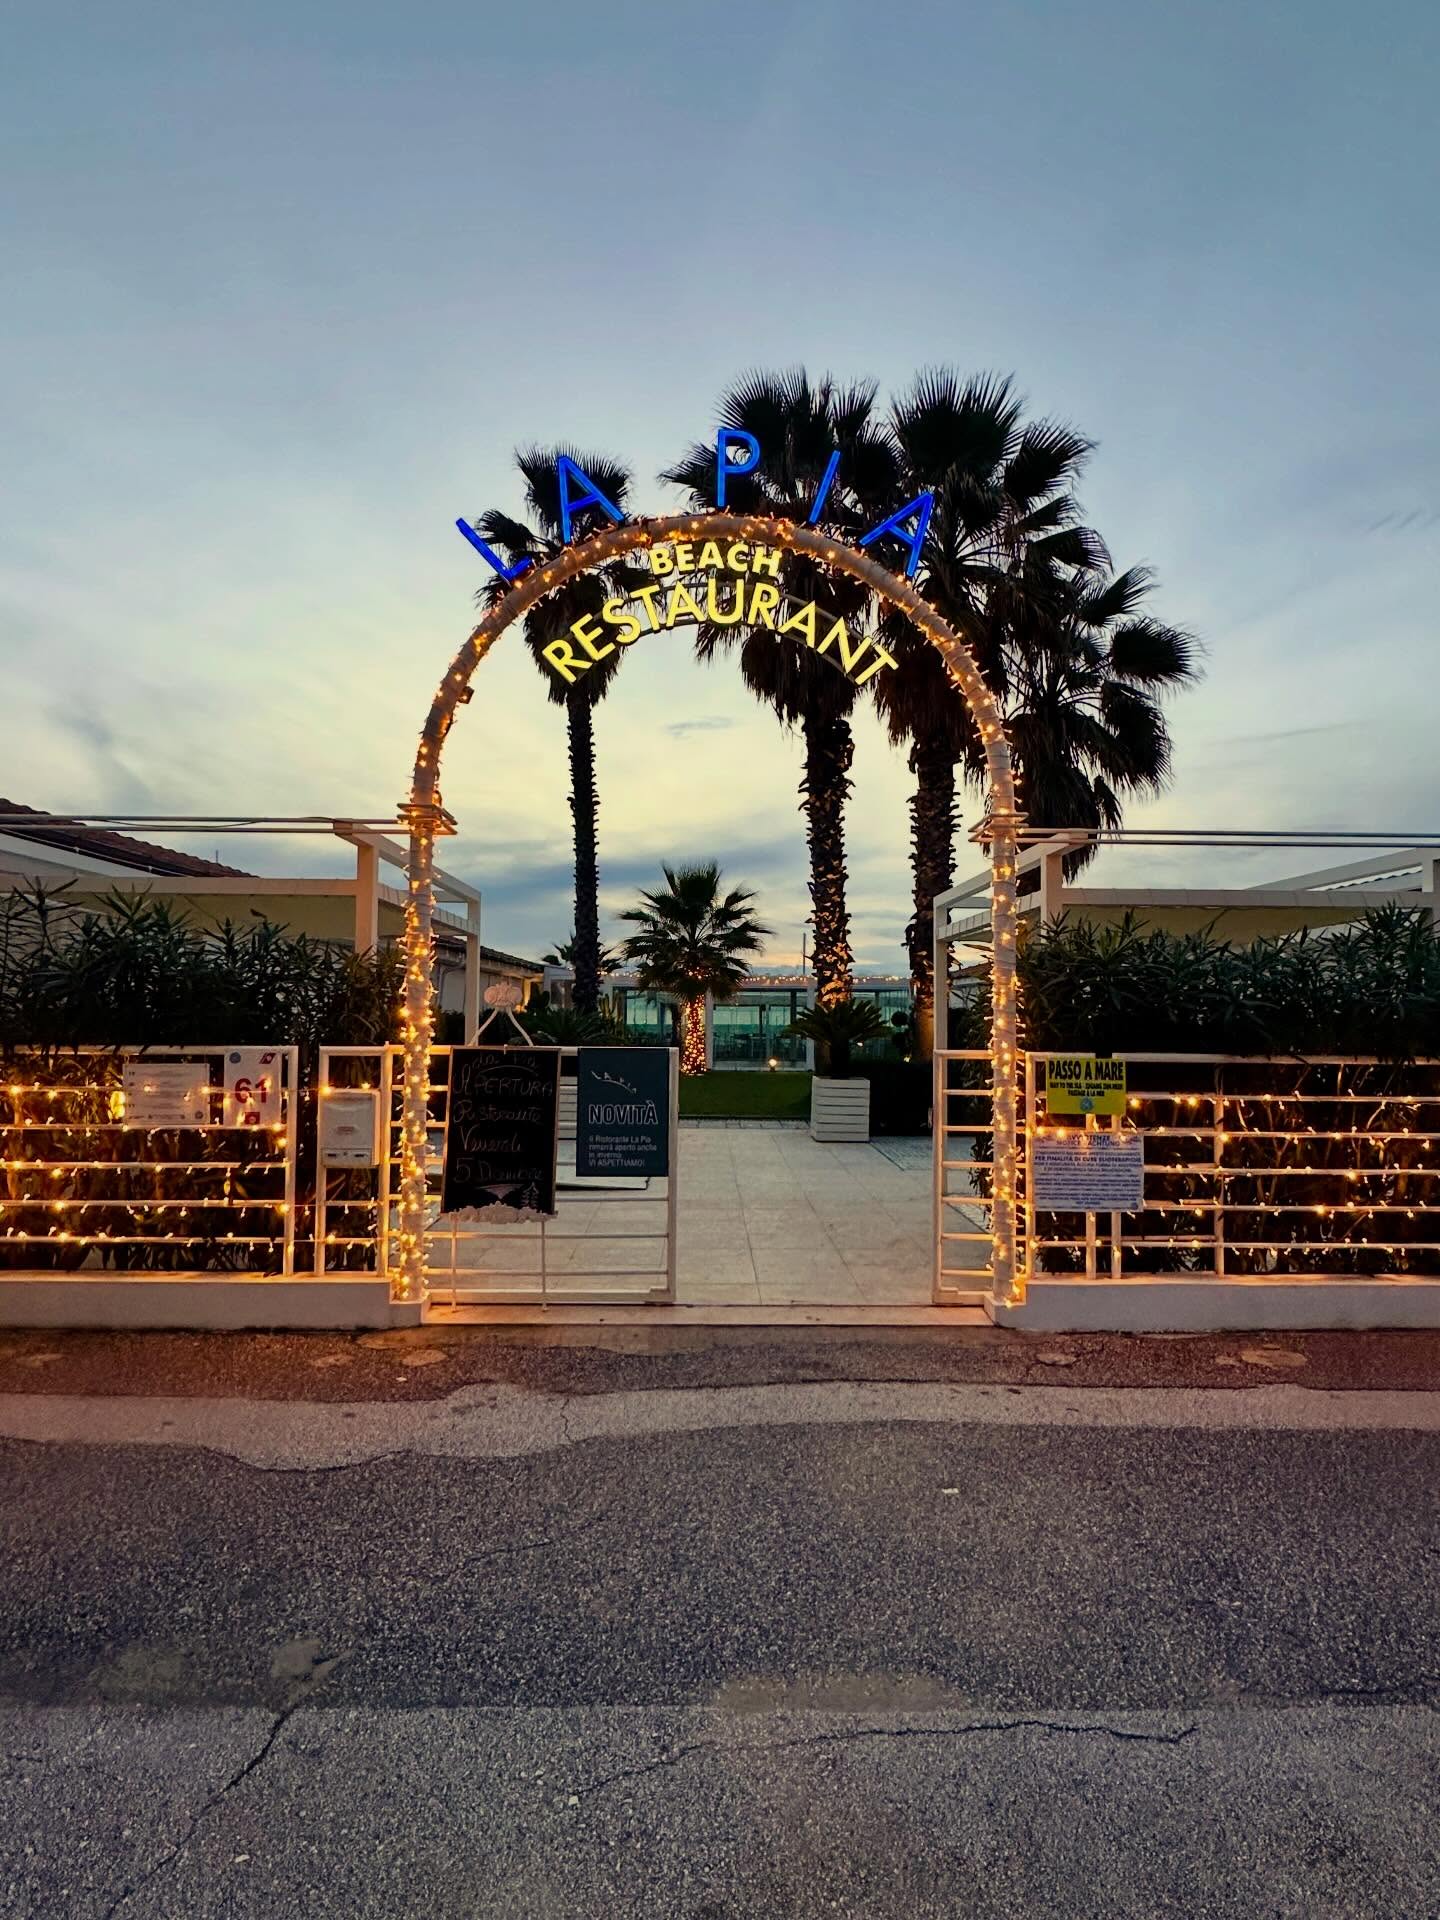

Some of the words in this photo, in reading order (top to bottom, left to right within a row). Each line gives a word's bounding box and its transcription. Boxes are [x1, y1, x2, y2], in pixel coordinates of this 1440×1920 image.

[717, 428, 935, 577] PIA
[649, 541, 783, 577] BEACH
[541, 578, 899, 685] RESTAURANT
[1048, 1060, 1082, 1080] PASSO
[1084, 1061, 1093, 1080] A
[1095, 1061, 1124, 1081] MARE
[234, 1078, 268, 1104] 61
[588, 1100, 658, 1125] NOVITÀ
[454, 1157, 474, 1184] 5
